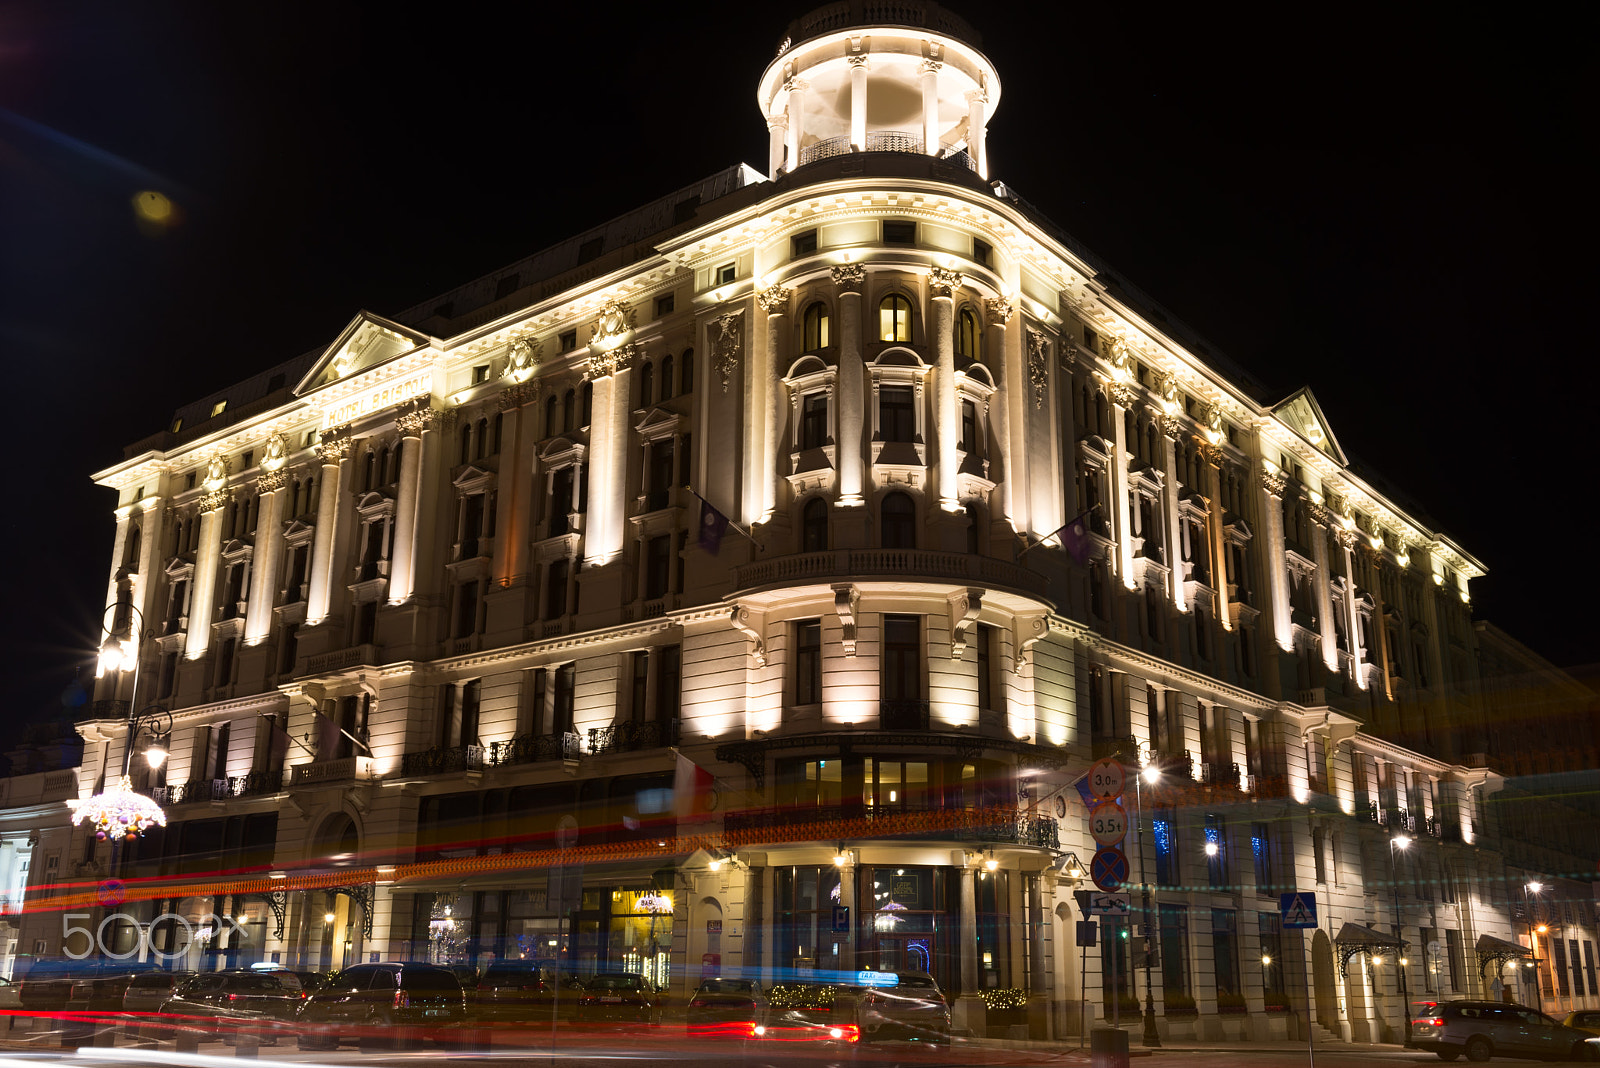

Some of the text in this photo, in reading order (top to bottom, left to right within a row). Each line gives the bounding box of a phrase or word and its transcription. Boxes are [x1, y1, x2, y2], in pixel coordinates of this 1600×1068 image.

[328, 376, 426, 426] HOTEL BRISTOL
[836, 907, 846, 930] P
